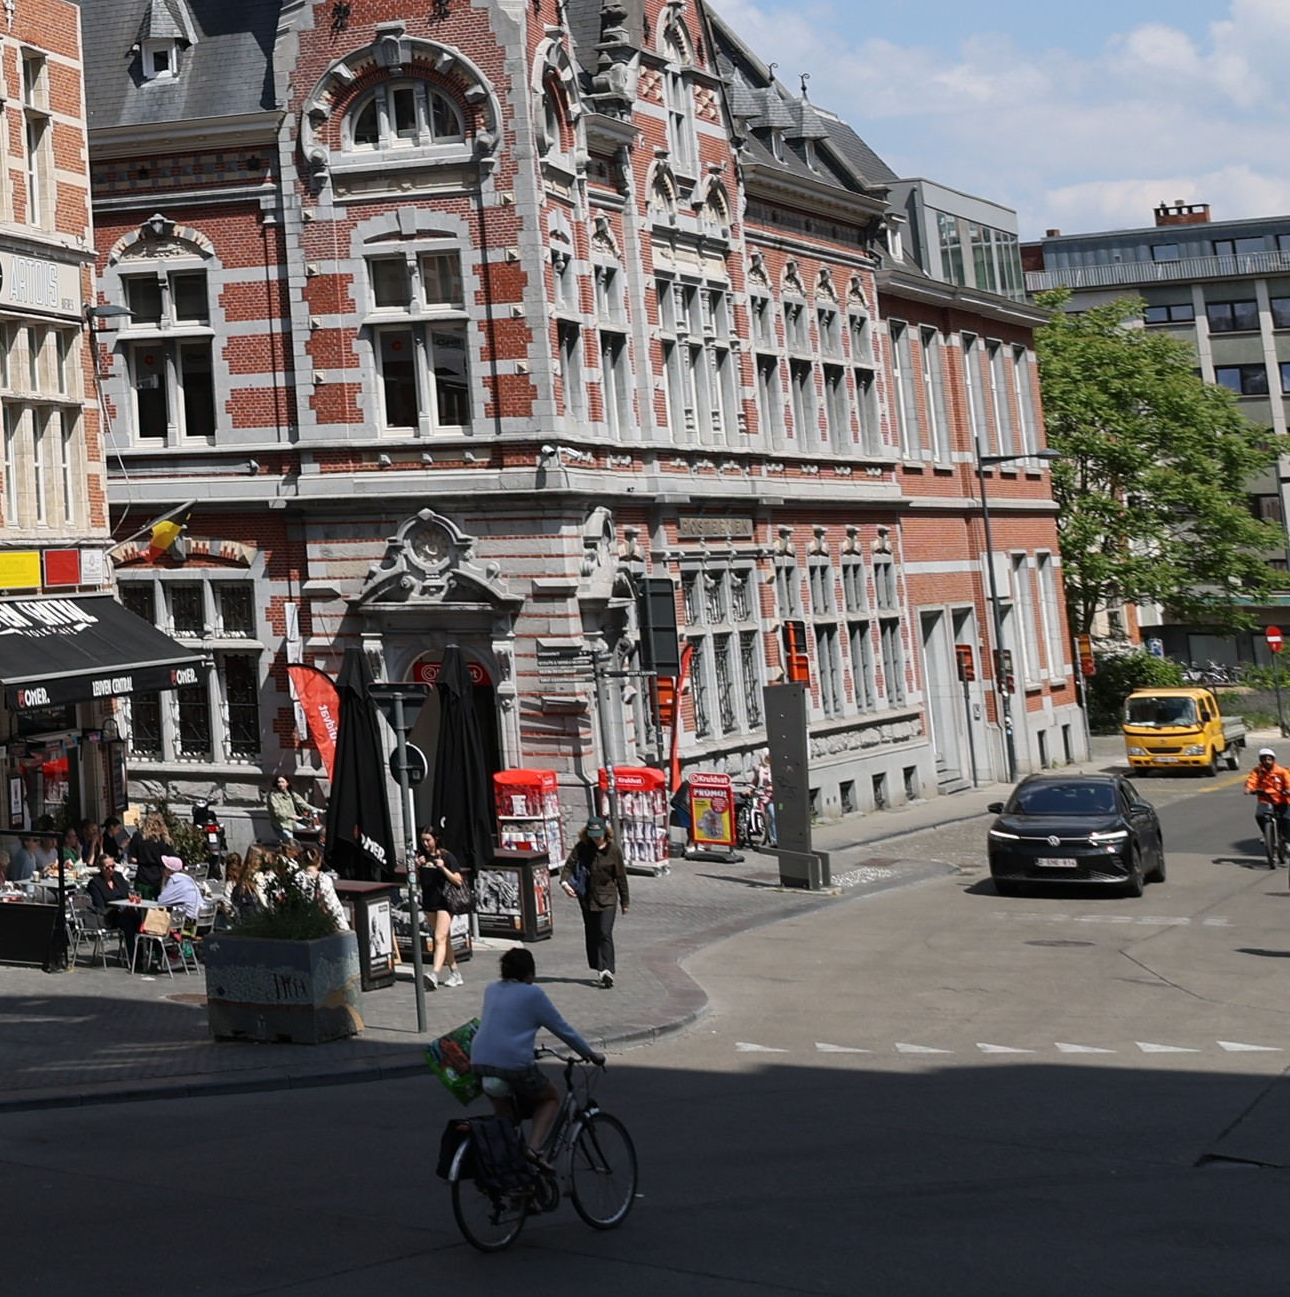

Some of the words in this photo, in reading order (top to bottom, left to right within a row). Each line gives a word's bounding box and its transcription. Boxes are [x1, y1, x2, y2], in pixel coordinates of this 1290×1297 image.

[9, 255, 59, 309] ARTOIS
[176, 668, 198, 685] OMER.
[92, 679, 112, 696] LEUVEN
[112, 676, 134, 694] CENTRAL
[24, 687, 51, 707] OMER.
[698, 775, 729, 784] Kruidvat
[693, 789, 727, 799] PROMO!
